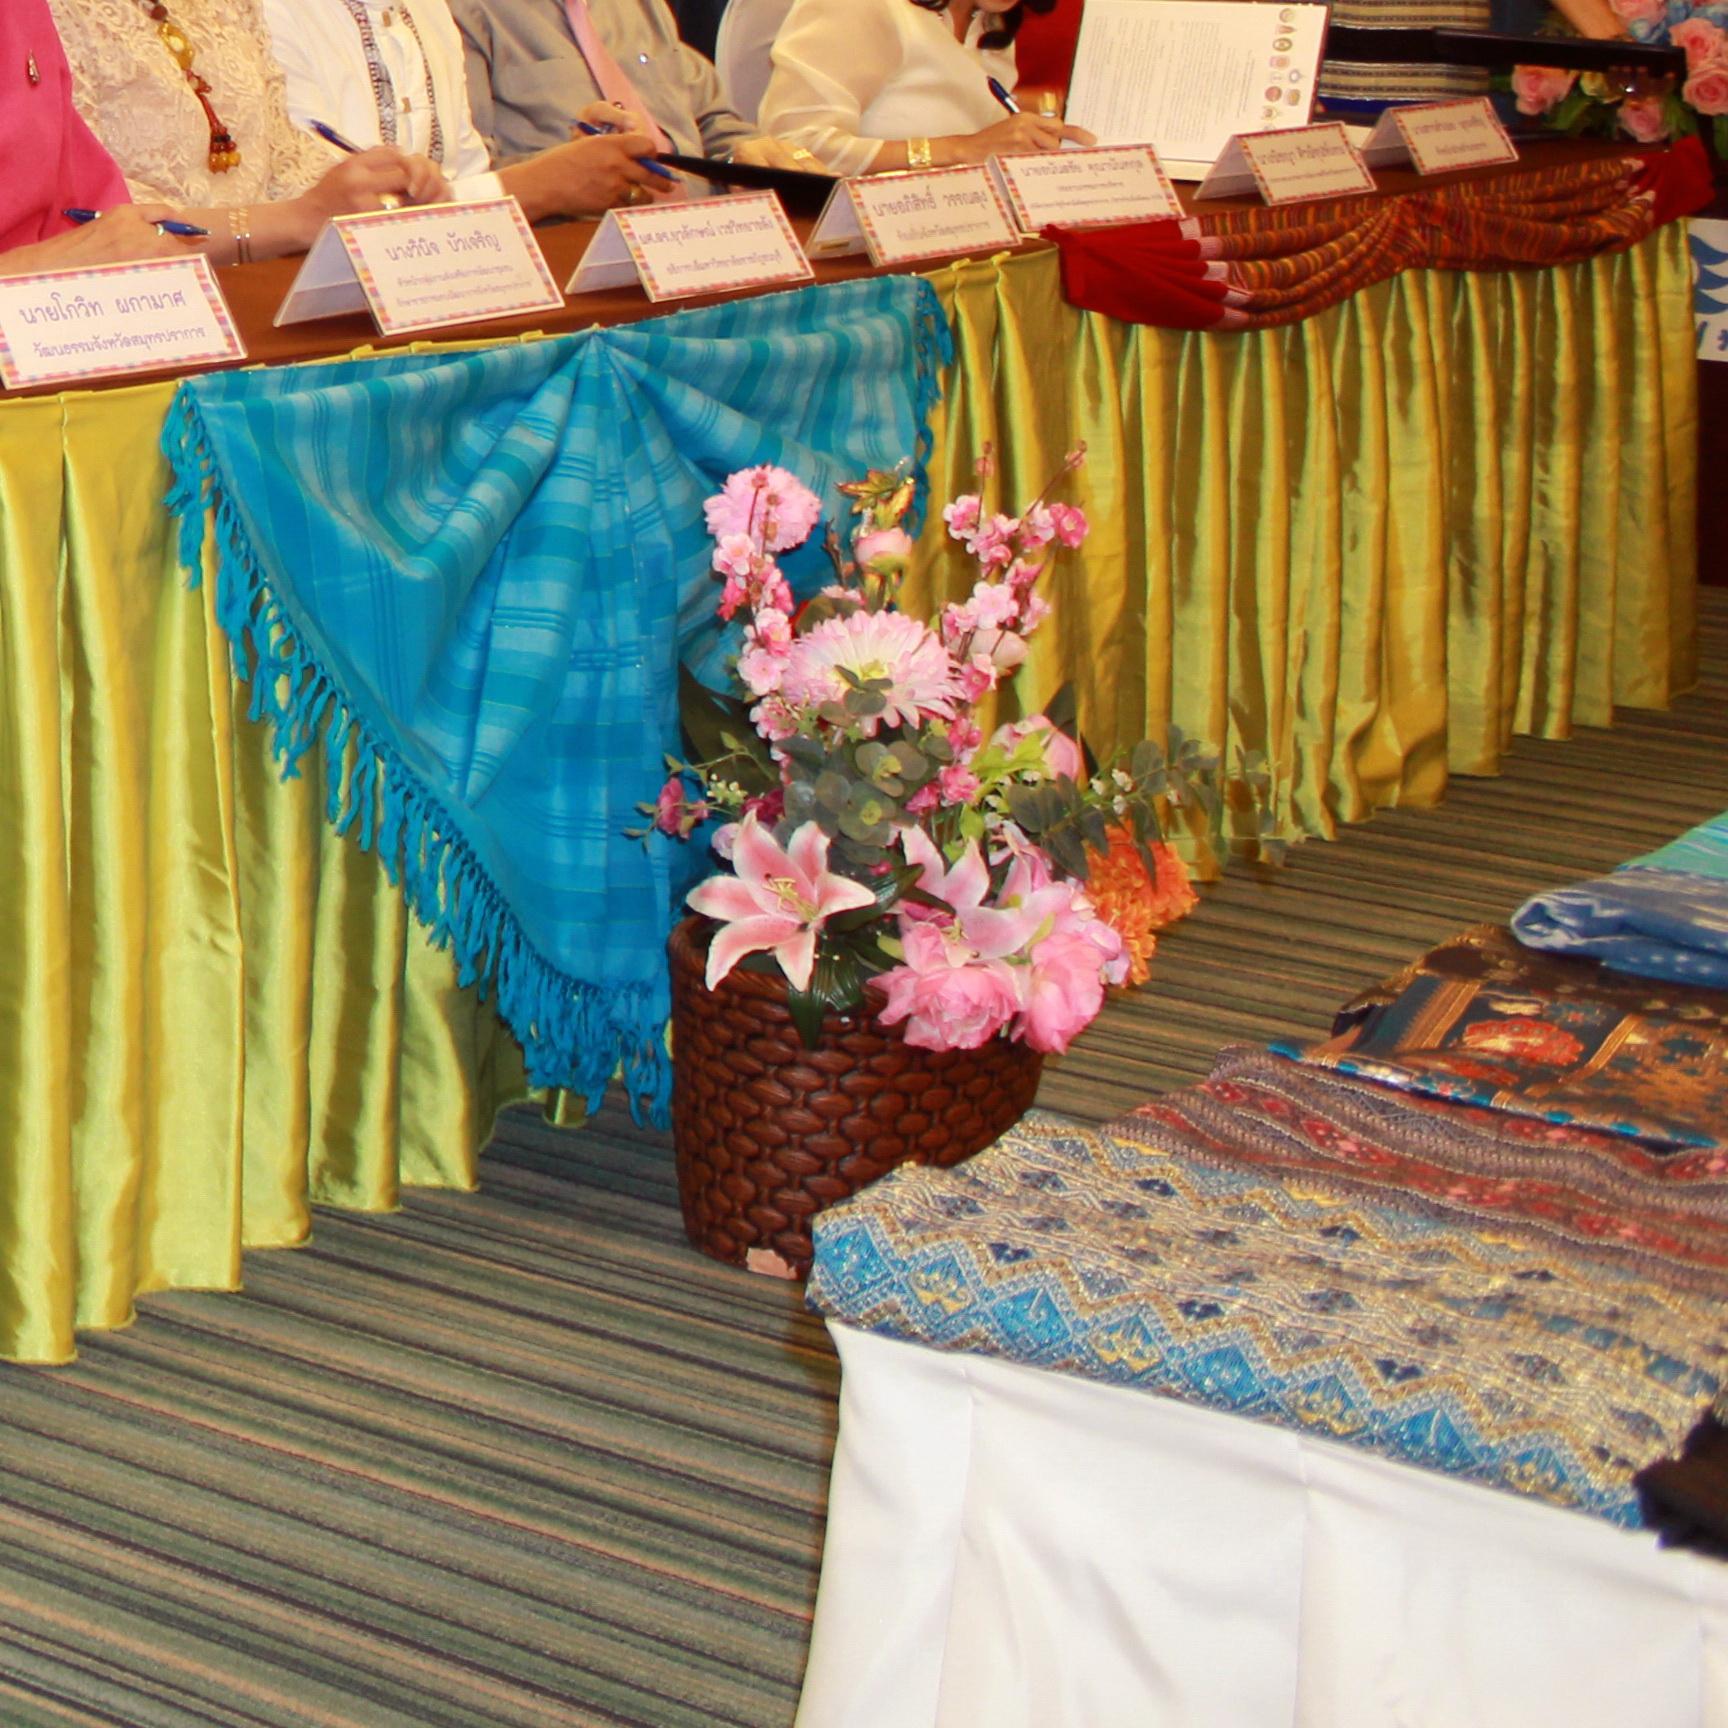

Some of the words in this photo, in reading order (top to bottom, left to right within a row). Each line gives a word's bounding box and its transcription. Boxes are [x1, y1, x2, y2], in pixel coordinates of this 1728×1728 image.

[447, 229, 502, 254] บัวเจริญ
[19, 291, 105, 325] นายโกวิท
[115, 289, 187, 313] ผกามาศ
[32, 325, 206, 359] วัฒนธรรมจังหวัดสมุทรปราการ
